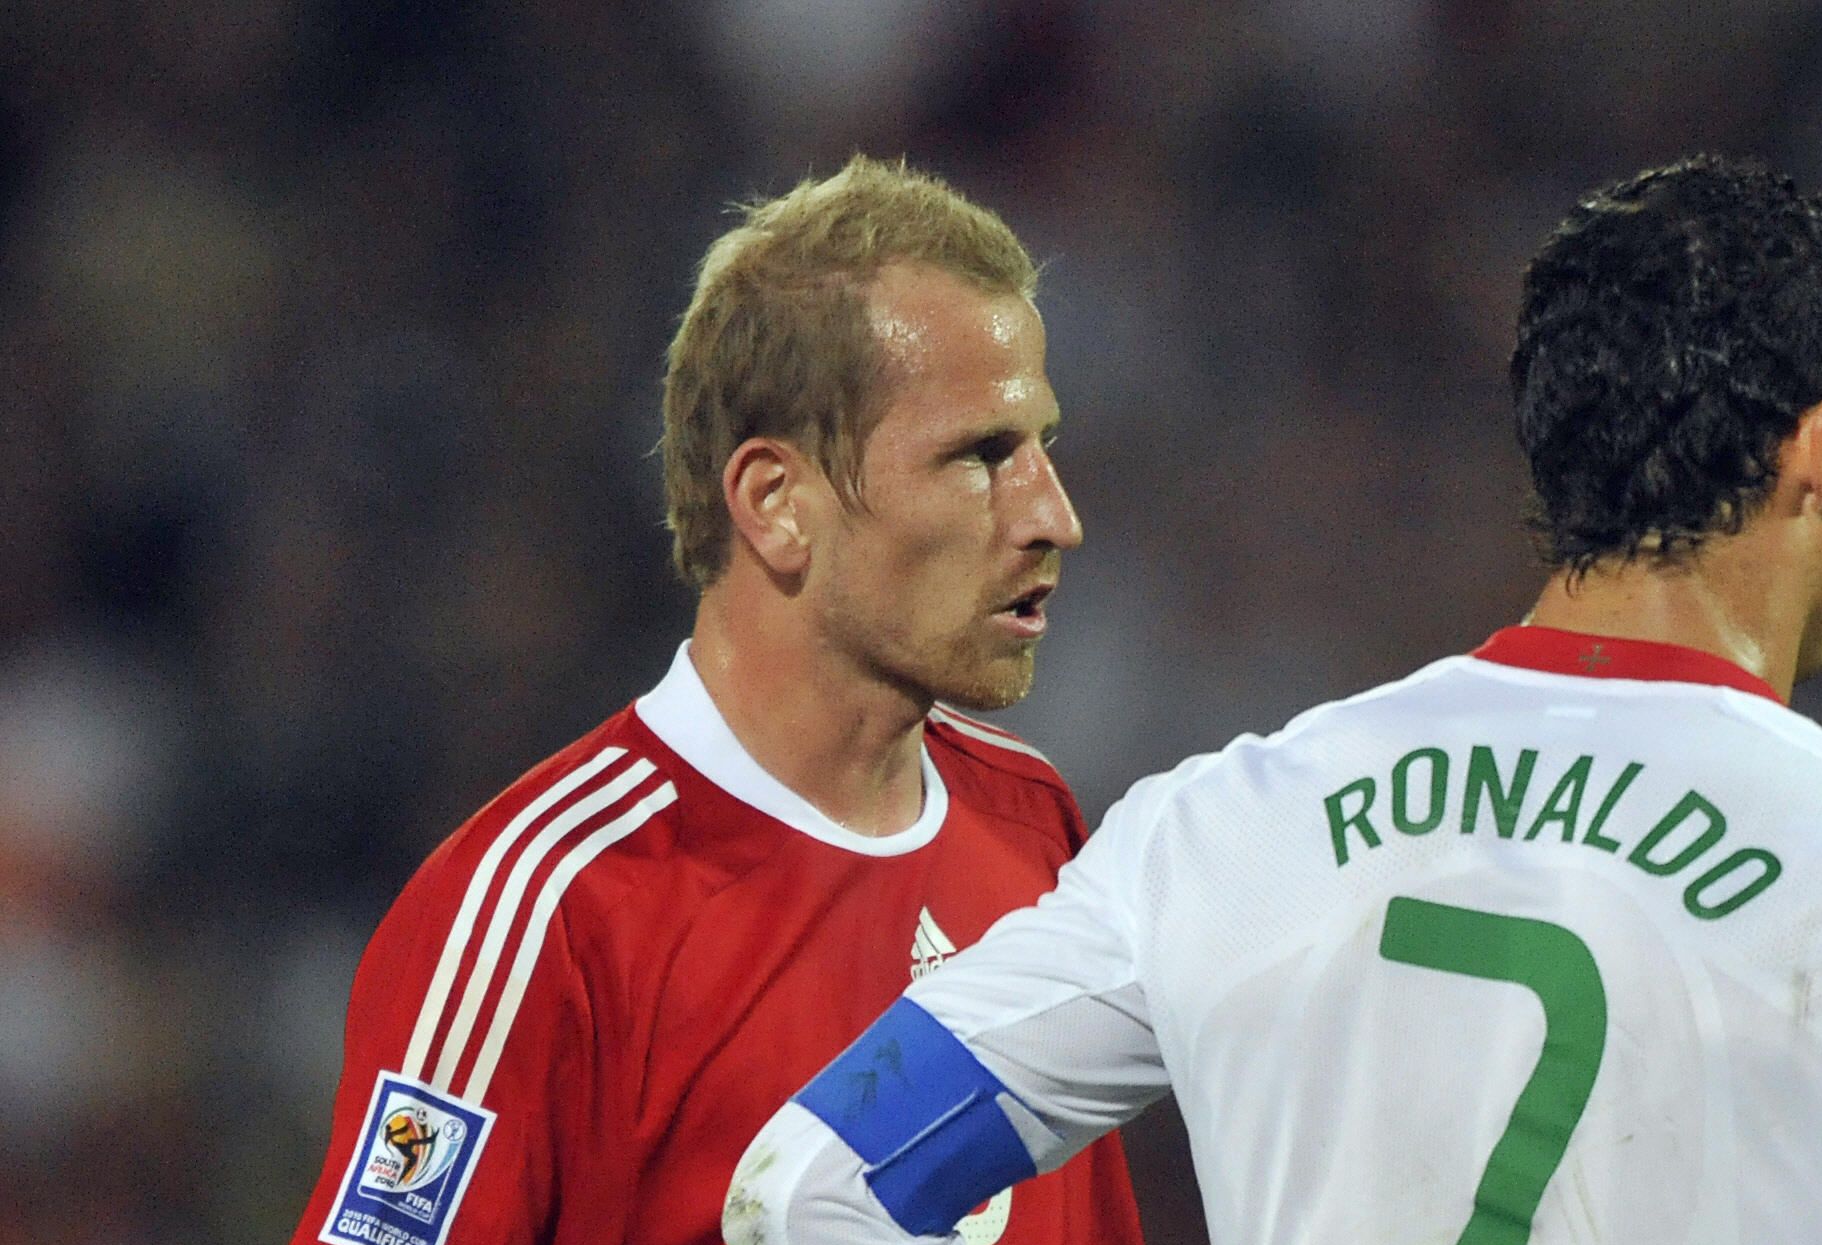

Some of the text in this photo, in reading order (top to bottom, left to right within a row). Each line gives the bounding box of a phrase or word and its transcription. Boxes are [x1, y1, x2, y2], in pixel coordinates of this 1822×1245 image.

[1324, 745, 1783, 921] RONALDO
[406, 1193, 432, 1213] FIFA
[382, 1223, 409, 1240] WORLD
